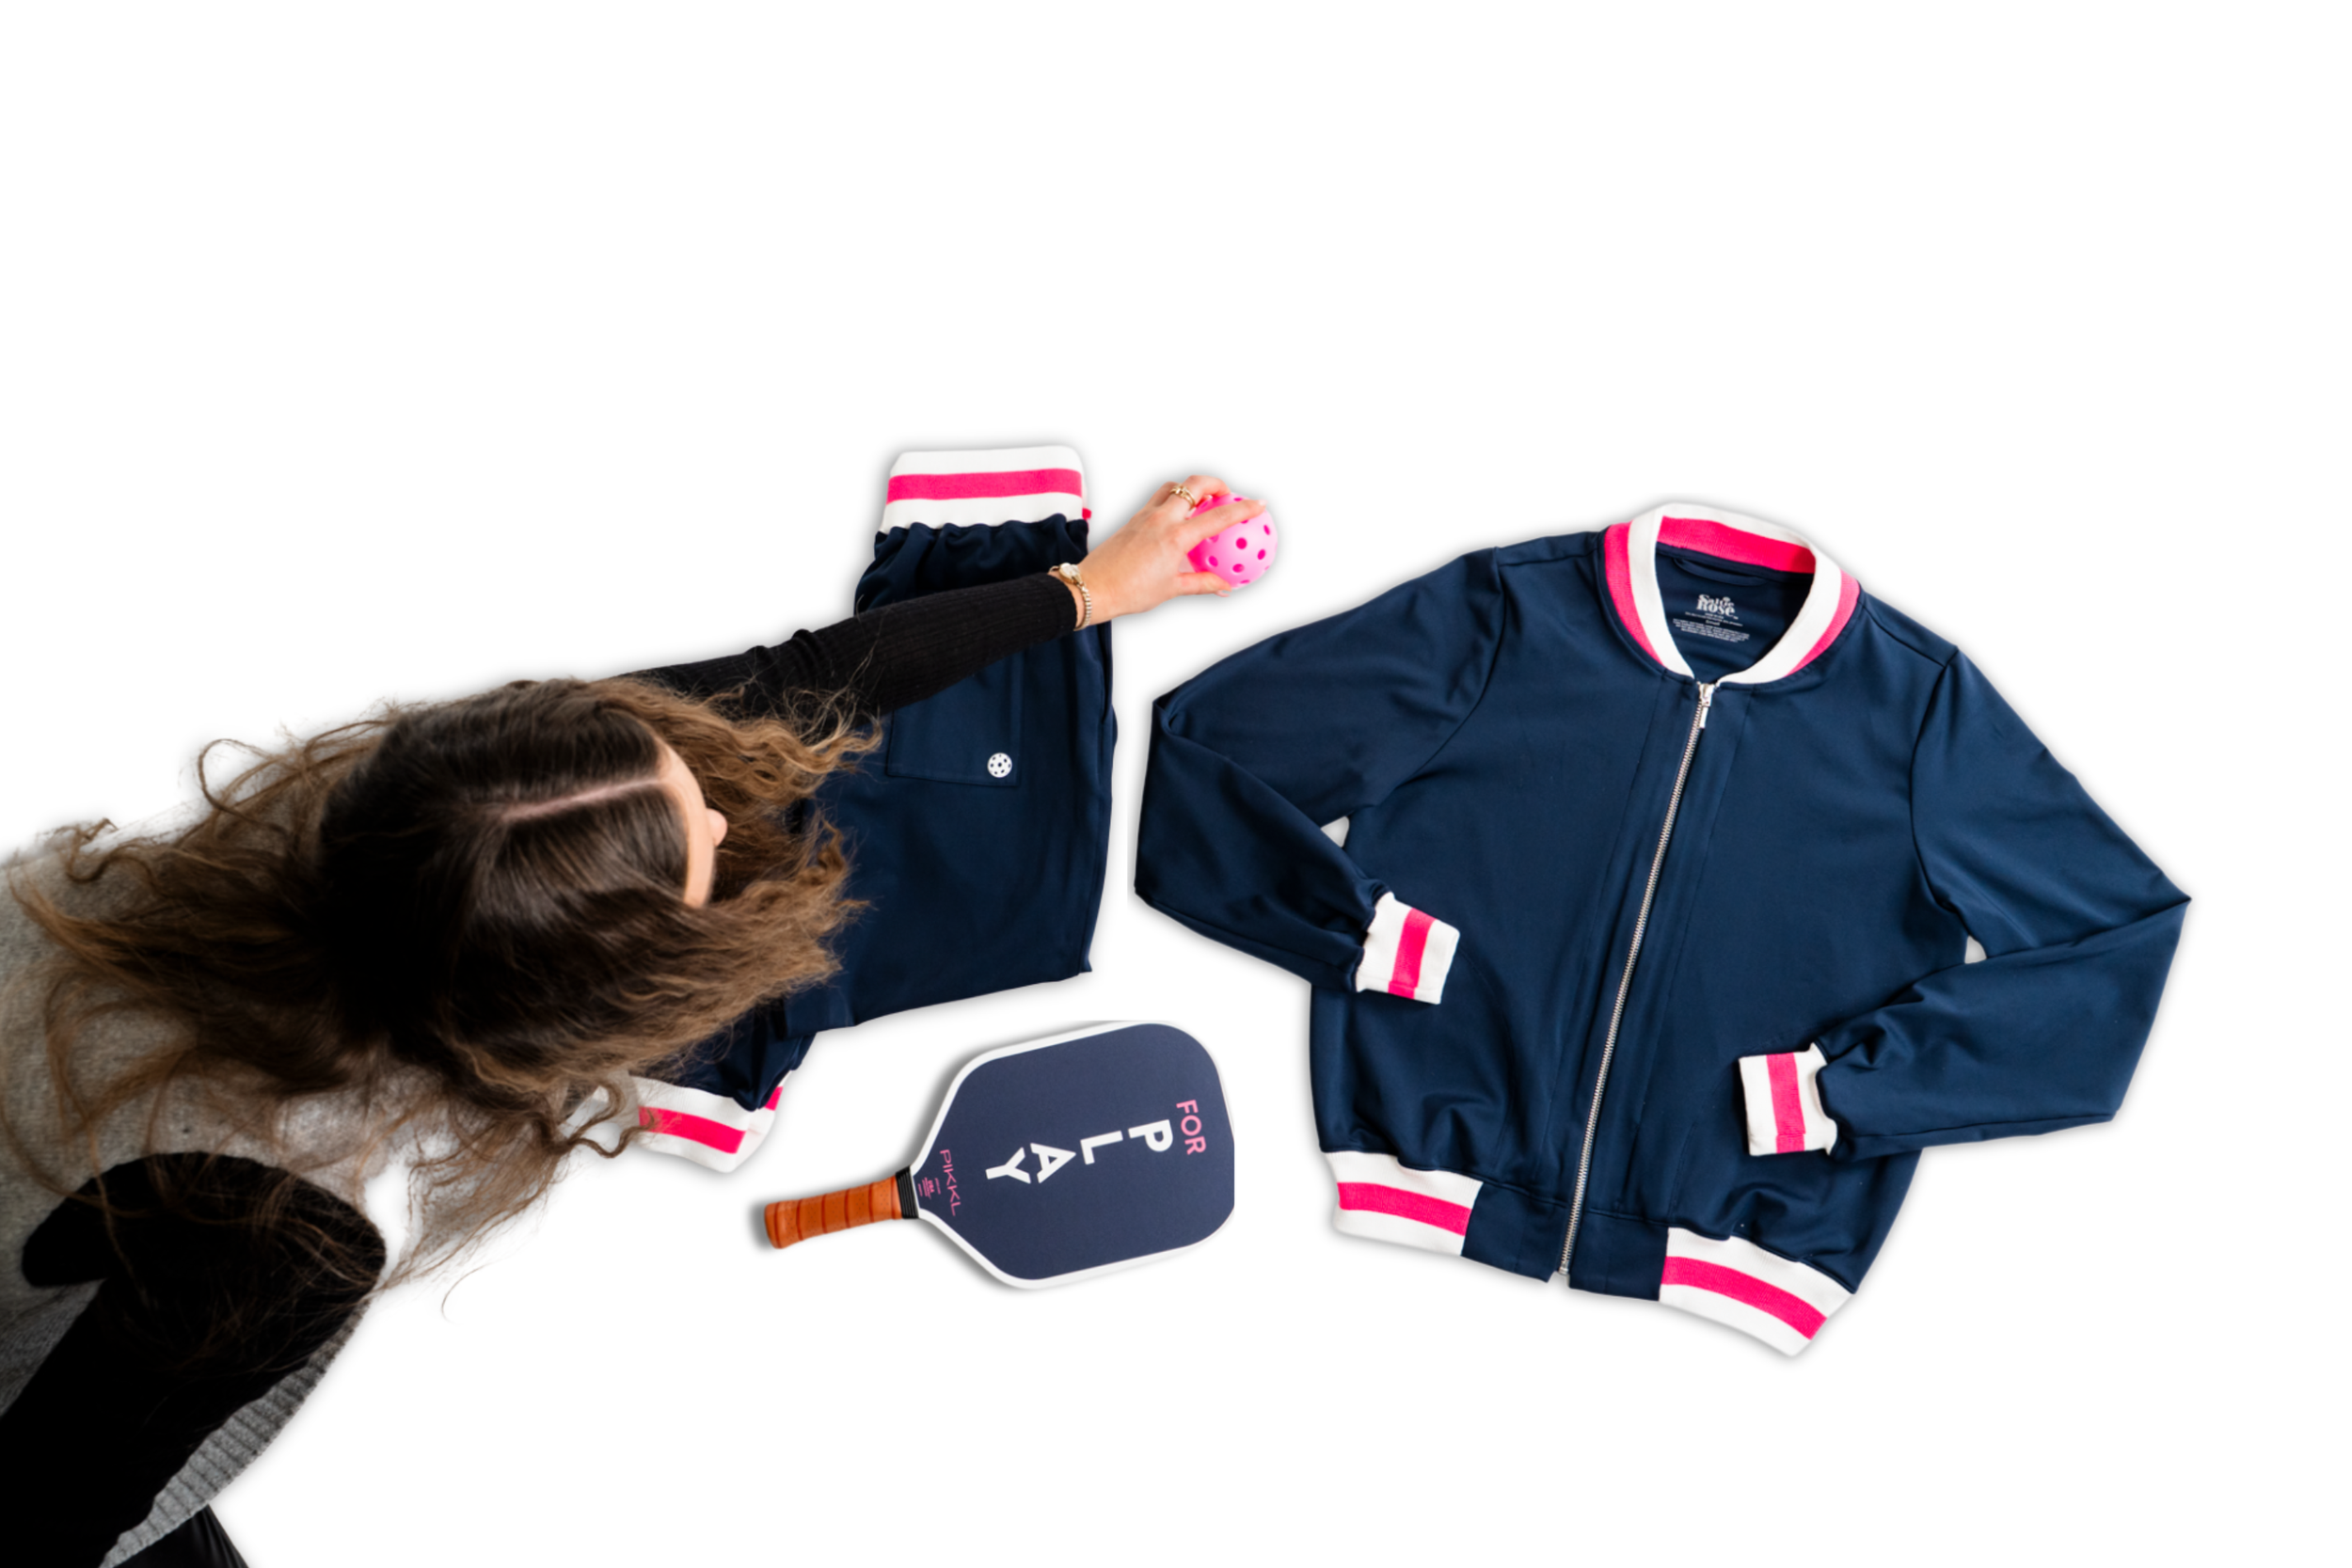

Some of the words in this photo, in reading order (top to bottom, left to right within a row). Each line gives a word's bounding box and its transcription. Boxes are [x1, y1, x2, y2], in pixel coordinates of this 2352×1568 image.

[985, 1119, 1173, 1184] PLAY
[1176, 1100, 1207, 1156] FOR
[940, 1148, 961, 1217] PIKKL
